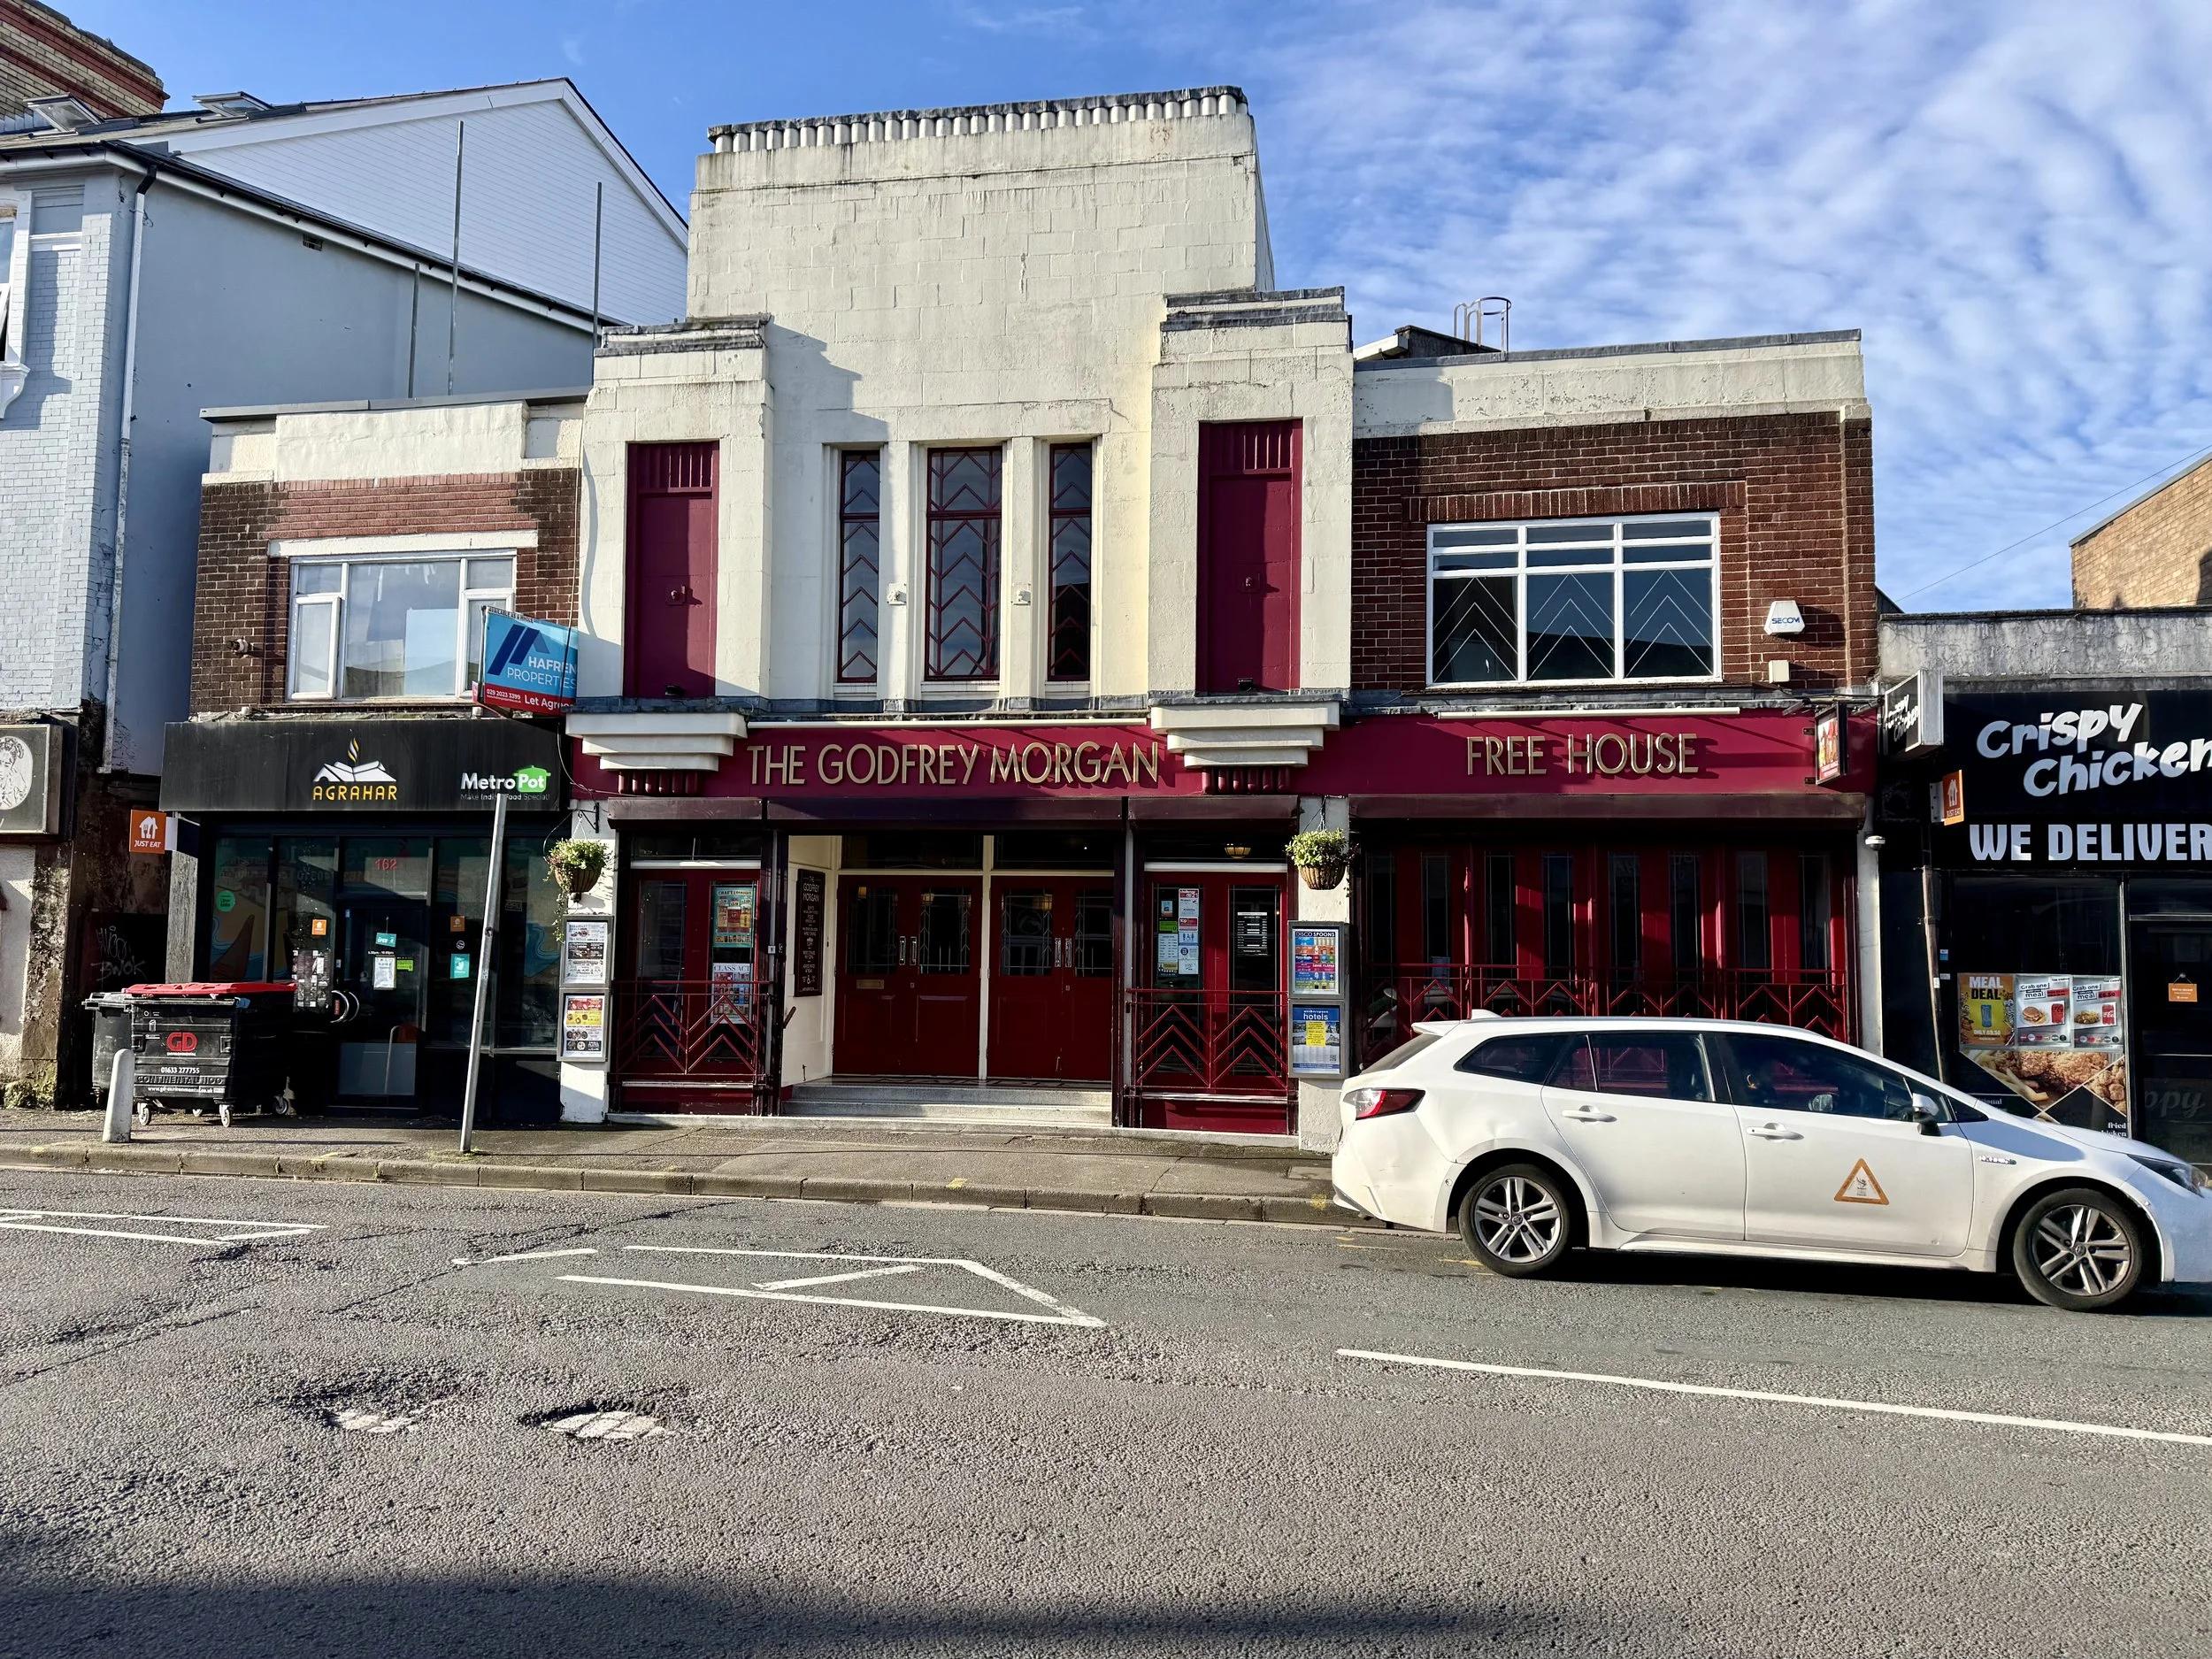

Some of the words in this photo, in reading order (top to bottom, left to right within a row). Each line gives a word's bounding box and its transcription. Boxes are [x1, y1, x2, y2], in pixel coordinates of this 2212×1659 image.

[528, 656, 577, 673] HAFREN
[507, 666, 577, 689] PROPERTIES
[524, 694, 540, 706] Let
[1976, 703, 2144, 758] Crispy
[746, 745, 806, 785] THE
[818, 743, 979, 785] GODFREY
[989, 741, 1158, 784] MORGAN
[1467, 735, 1547, 775] FREE
[1567, 732, 1698, 774] HOUSE
[2023, 738, 2212, 797] Chicken
[312, 785, 397, 801] AGRAHAR
[1969, 824, 2032, 861] WE
[2047, 823, 2212, 861] DELIVER
[374, 858, 397, 871] 162
[1969, 976, 2003, 988] MEAL
[1971, 988, 2001, 1000] DEAL
[166, 1032, 198, 1052] GD
